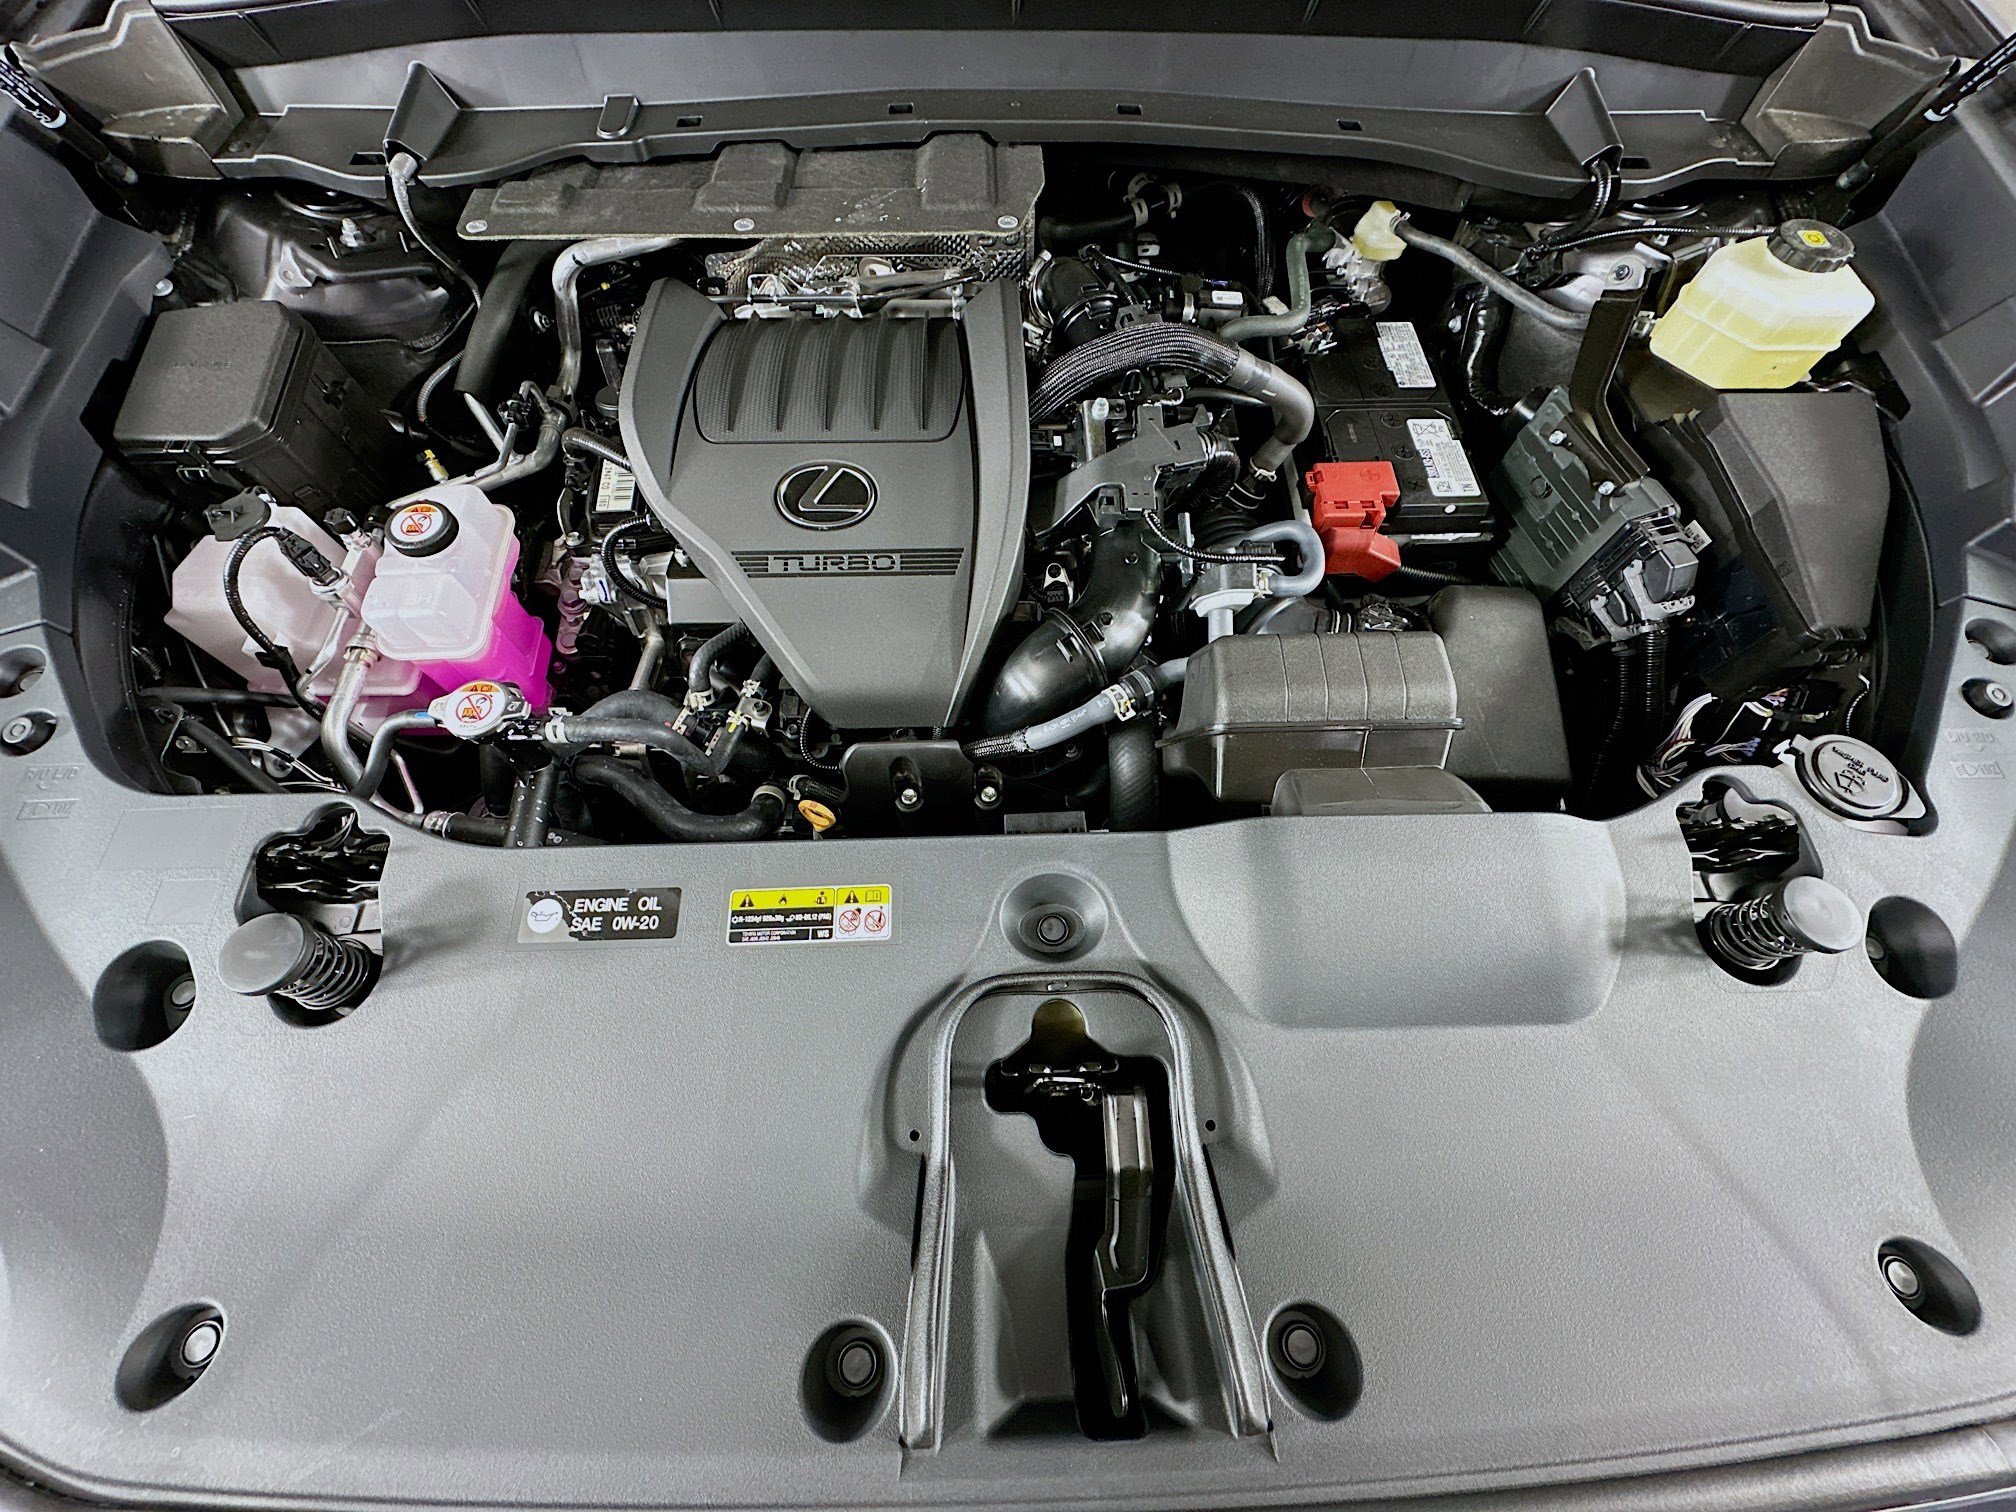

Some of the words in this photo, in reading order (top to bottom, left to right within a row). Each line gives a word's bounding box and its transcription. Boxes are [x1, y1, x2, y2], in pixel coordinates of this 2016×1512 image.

[773, 554, 897, 572] TURBO
[573, 897, 630, 913] ENGINE
[638, 896, 662, 911] OIL
[570, 916, 603, 932] SAE
[612, 915, 660, 931] 0W-20
